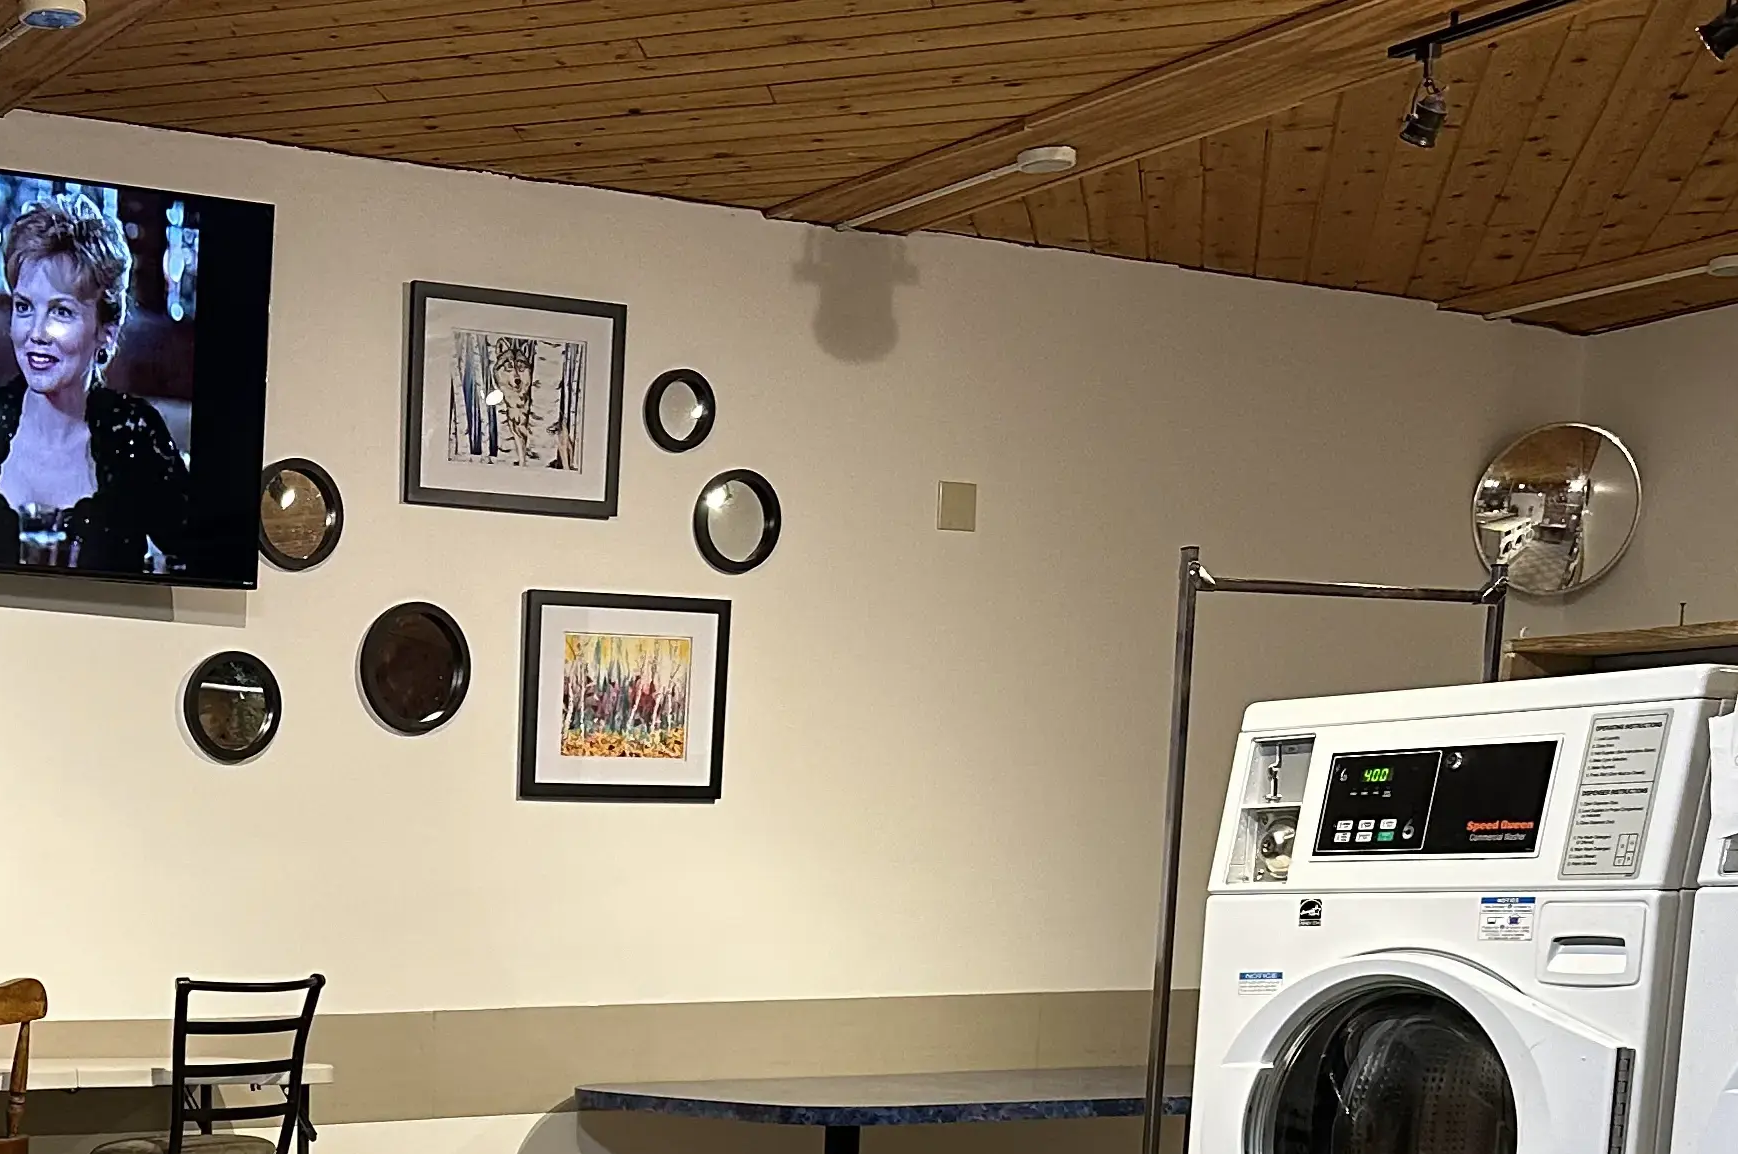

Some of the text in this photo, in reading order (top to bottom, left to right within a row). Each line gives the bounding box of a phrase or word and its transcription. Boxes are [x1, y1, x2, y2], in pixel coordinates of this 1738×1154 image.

[1364, 768, 1390, 782] 400
[1466, 820, 1535, 832] Speed Queen
